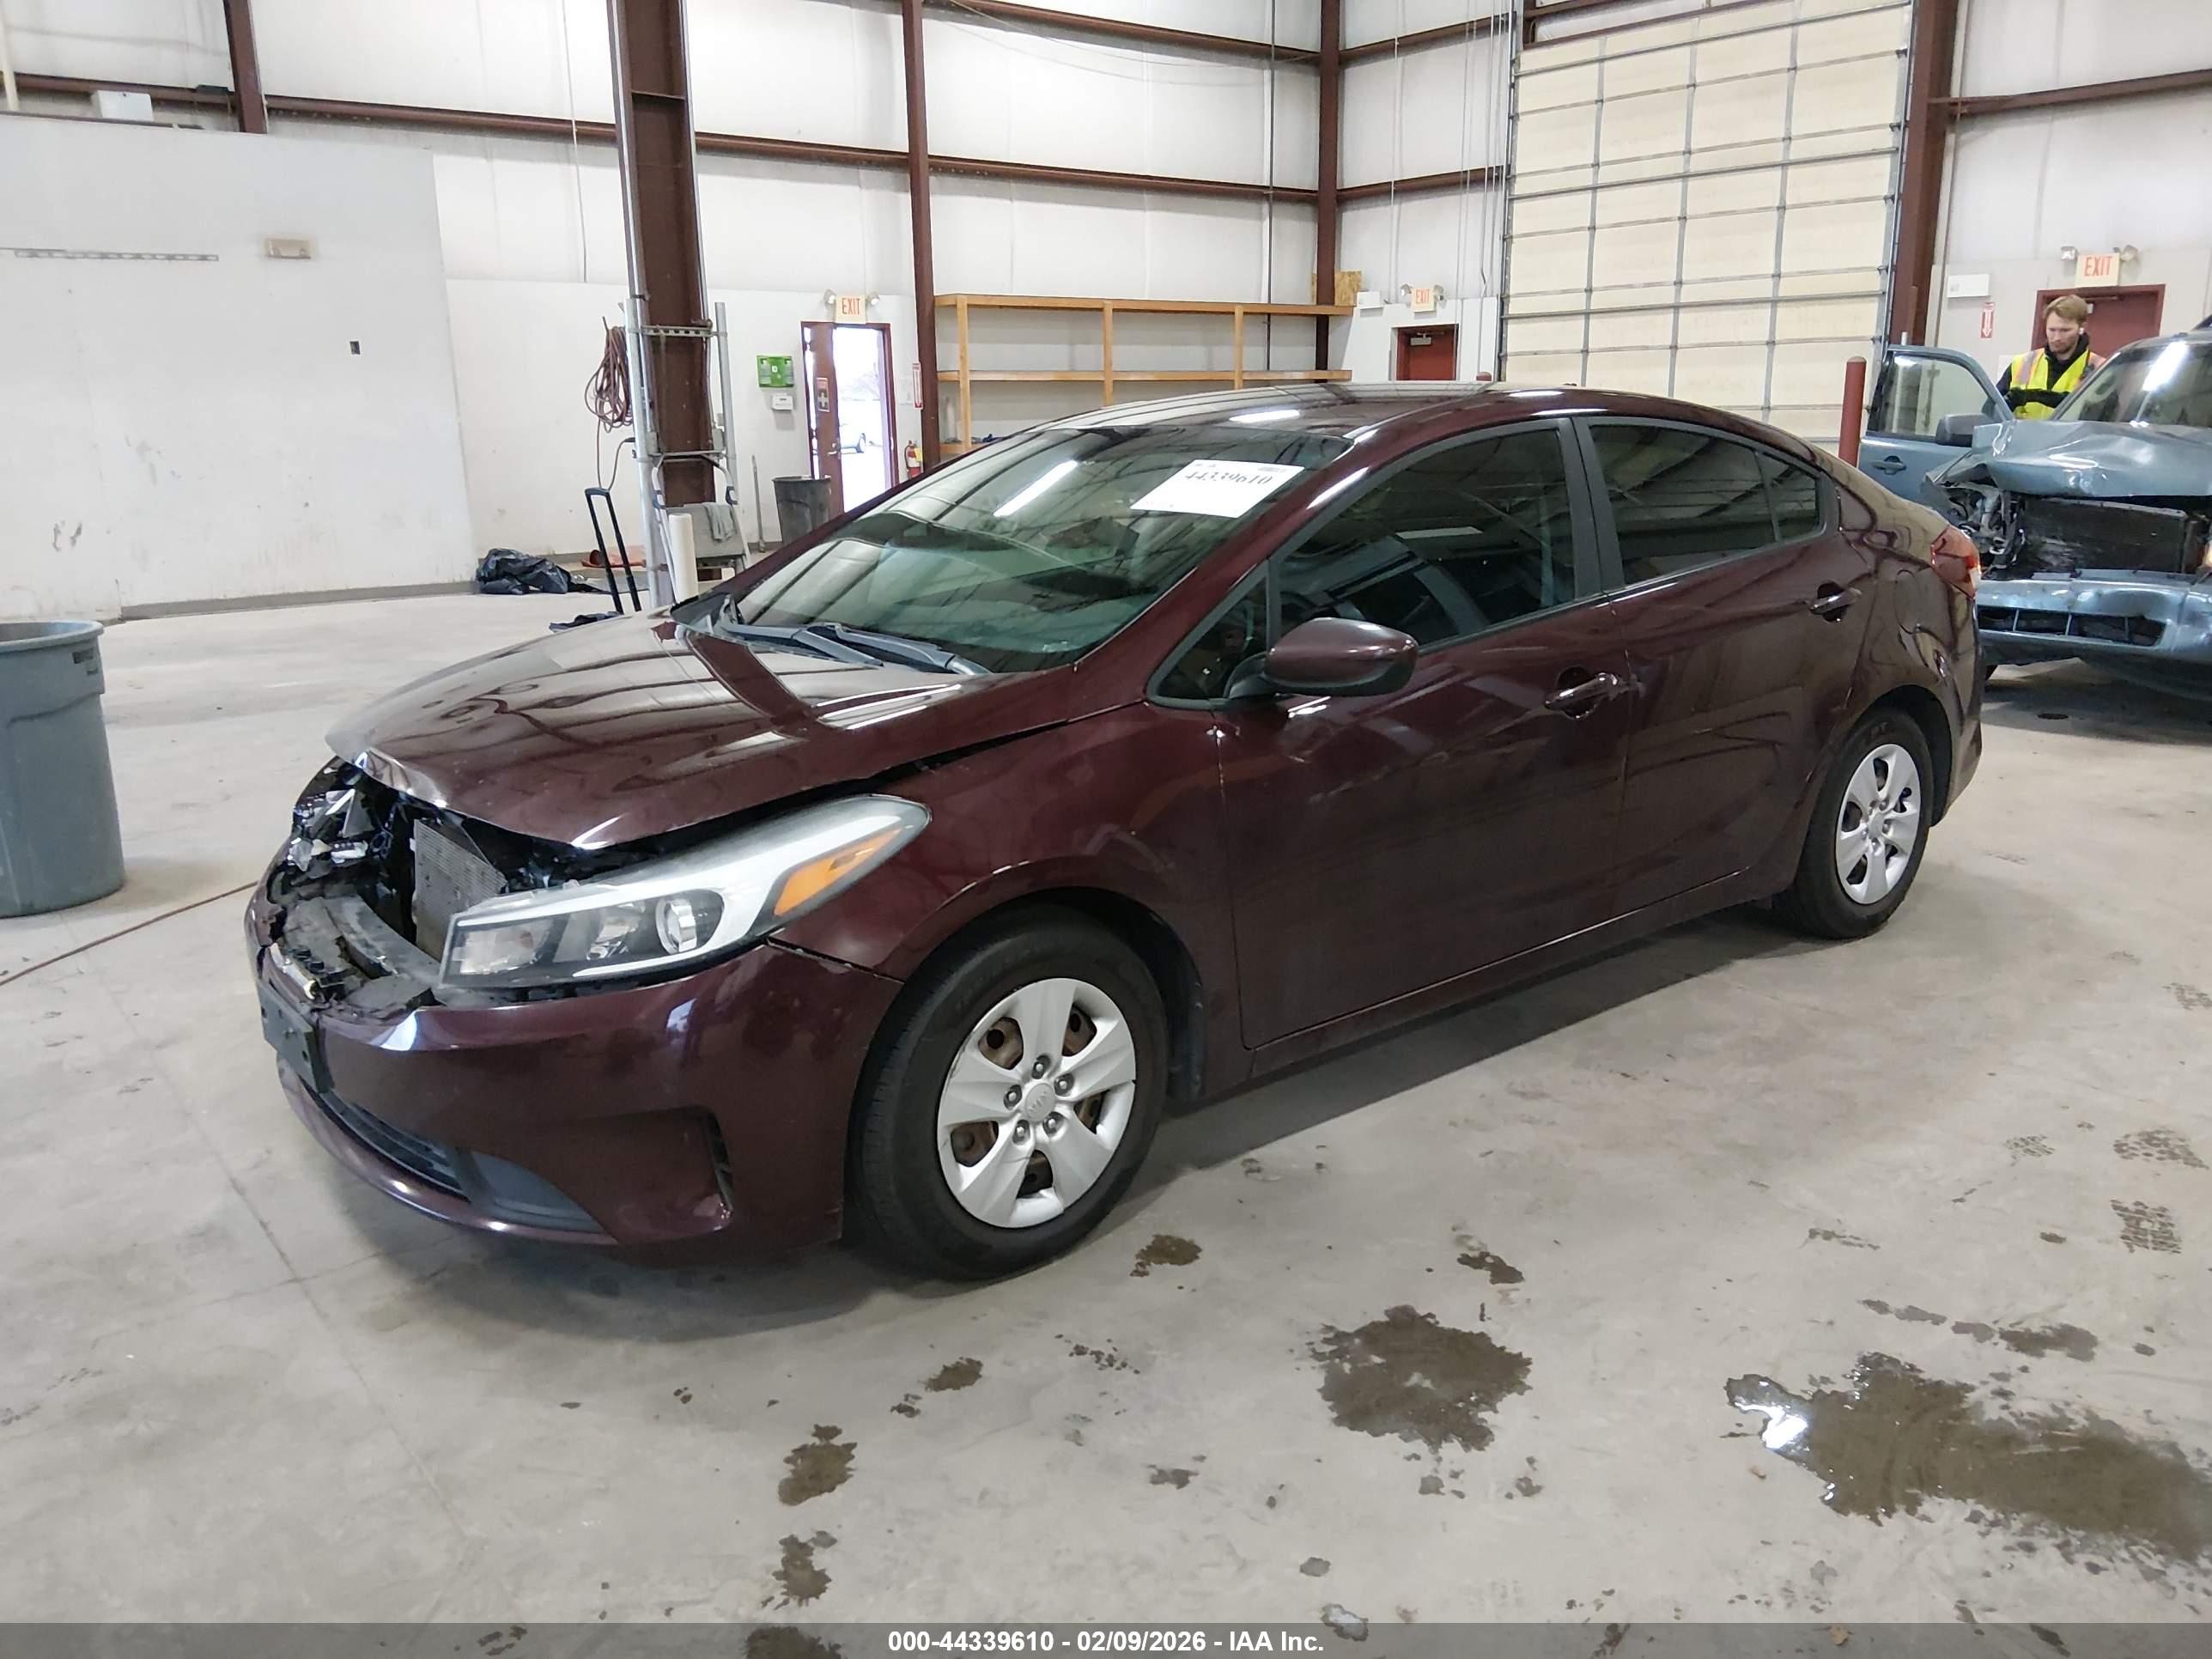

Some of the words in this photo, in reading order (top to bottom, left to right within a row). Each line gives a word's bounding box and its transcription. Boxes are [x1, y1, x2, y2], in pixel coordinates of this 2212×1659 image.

[2085, 257, 2112, 276] EXIT
[1415, 289, 1429, 303] EXIT
[842, 298, 860, 314] EXIT
[1185, 471, 1273, 484] 44339610
